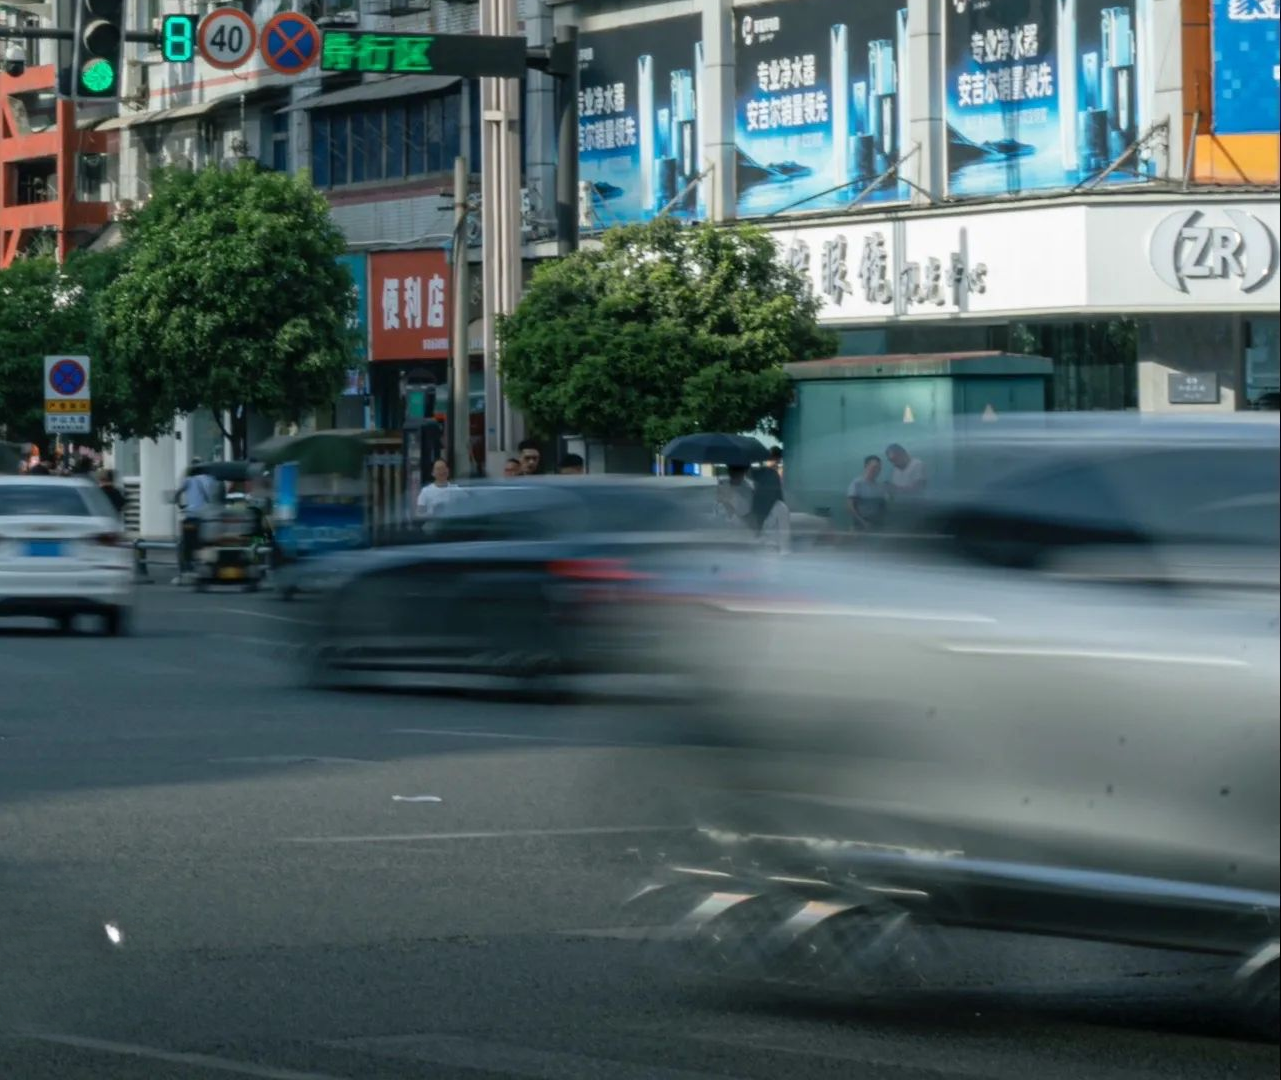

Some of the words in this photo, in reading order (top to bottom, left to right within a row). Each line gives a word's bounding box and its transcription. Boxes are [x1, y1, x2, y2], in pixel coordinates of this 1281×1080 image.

[165, 16, 192, 62] 8
[210, 24, 242, 54] 40
[971, 23, 1039, 63] 专业净水器
[757, 54, 816, 93] 专业净水器
[957, 63, 1053, 107] 安吉尔销量领先
[746, 89, 828, 132] 安吉尔销量领先
[578, 116, 637, 152] 吉尔销量领先
[1181, 226, 1246, 279] ZR
[382, 273, 444, 331] 便利店
